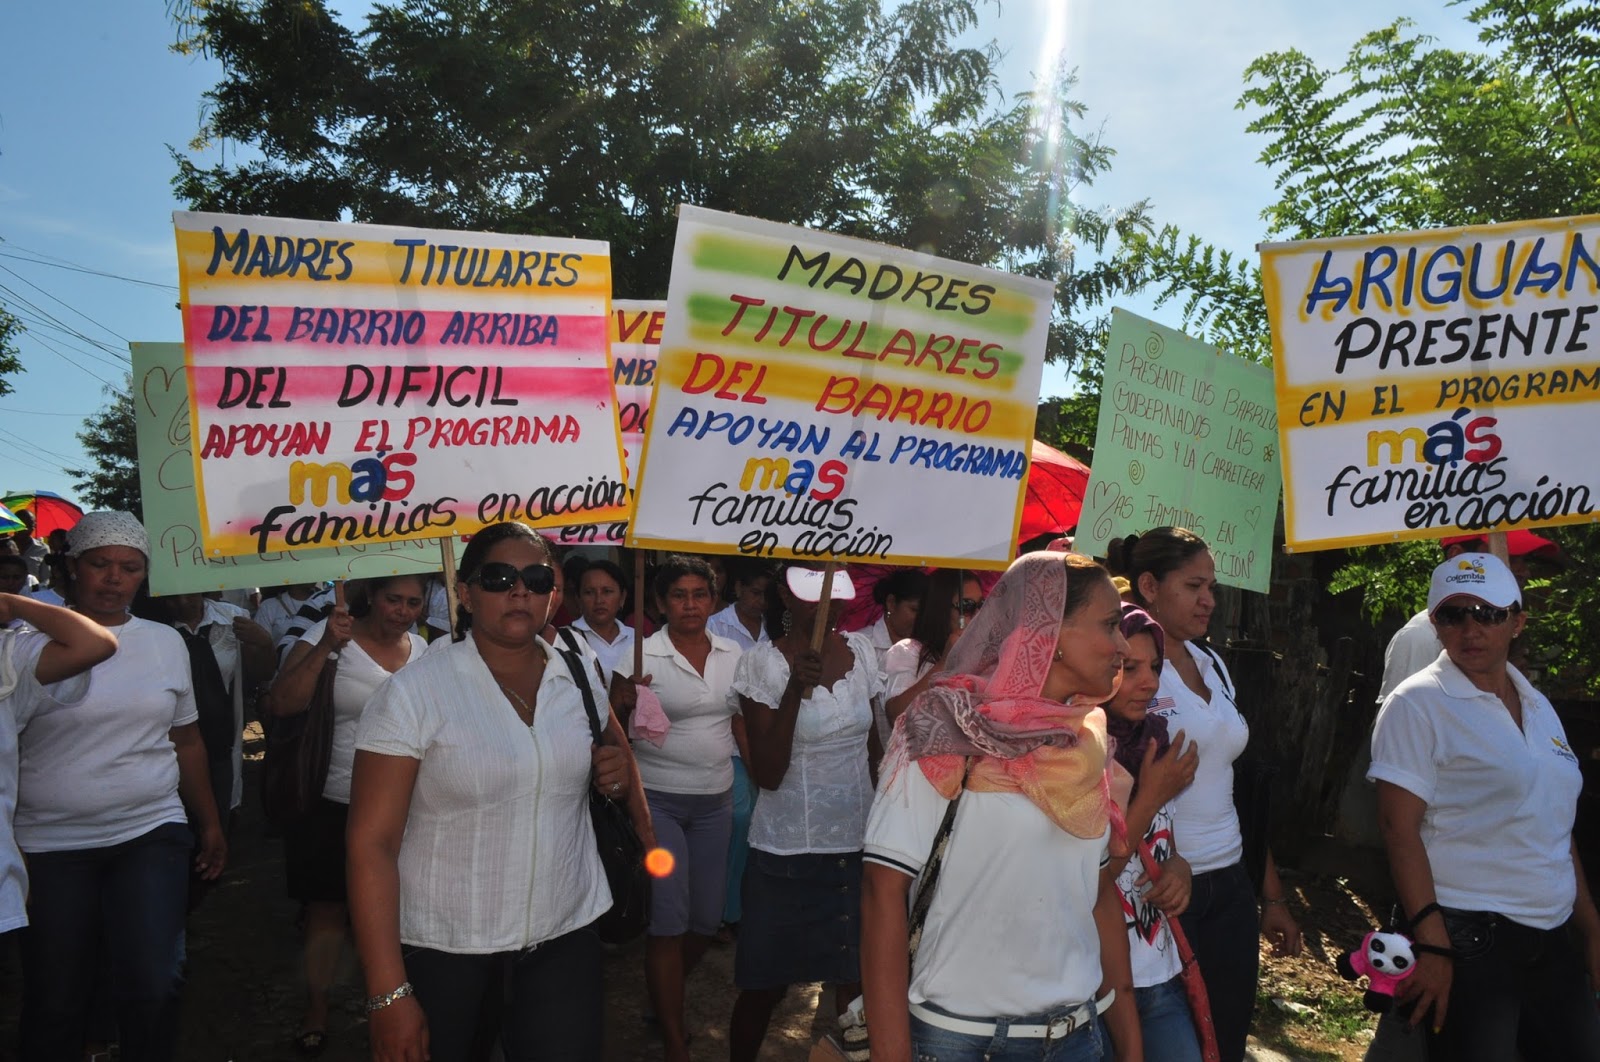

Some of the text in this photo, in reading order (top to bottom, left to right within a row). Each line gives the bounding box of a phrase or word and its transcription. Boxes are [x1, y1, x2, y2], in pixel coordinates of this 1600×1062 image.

[206, 226, 582, 287] MADRES TITULARES
[776, 244, 997, 316] MADRES
[208, 305, 559, 346] DEL BARRIO ARRIBA
[721, 294, 1004, 380] TITULARES
[1334, 305, 1599, 374] PRESENTE
[217, 366, 291, 409] DEL
[337, 365, 519, 408] DIFICIL
[681, 353, 991, 433] DEL BARRIO
[1118, 343, 1186, 397] PRESENTE
[1191, 378, 1216, 406] LOS
[1300, 390, 1346, 427] EN
[1371, 385, 1405, 416] EL
[200, 421, 331, 459] APOYAN
[354, 419, 390, 453] EL
[403, 414, 581, 451] PROGRAMA
[667, 406, 830, 456] APOYAN
[839, 430, 881, 463] AL
[889, 435, 1027, 480] PROGRAMA
[1111, 413, 1266, 494] PALMAS Y LA CARRETERA
[1227, 425, 1254, 456] LAS
[1366, 407, 1502, 467] más
[250, 474, 628, 553] familias en acción
[688, 482, 858, 531] familias
[1325, 455, 1509, 516] familias
[1404, 475, 1595, 530] en acción
[738, 526, 893, 559] en acción
[1216, 520, 1237, 547] EN
[1446, 573, 1485, 582] Colombia
